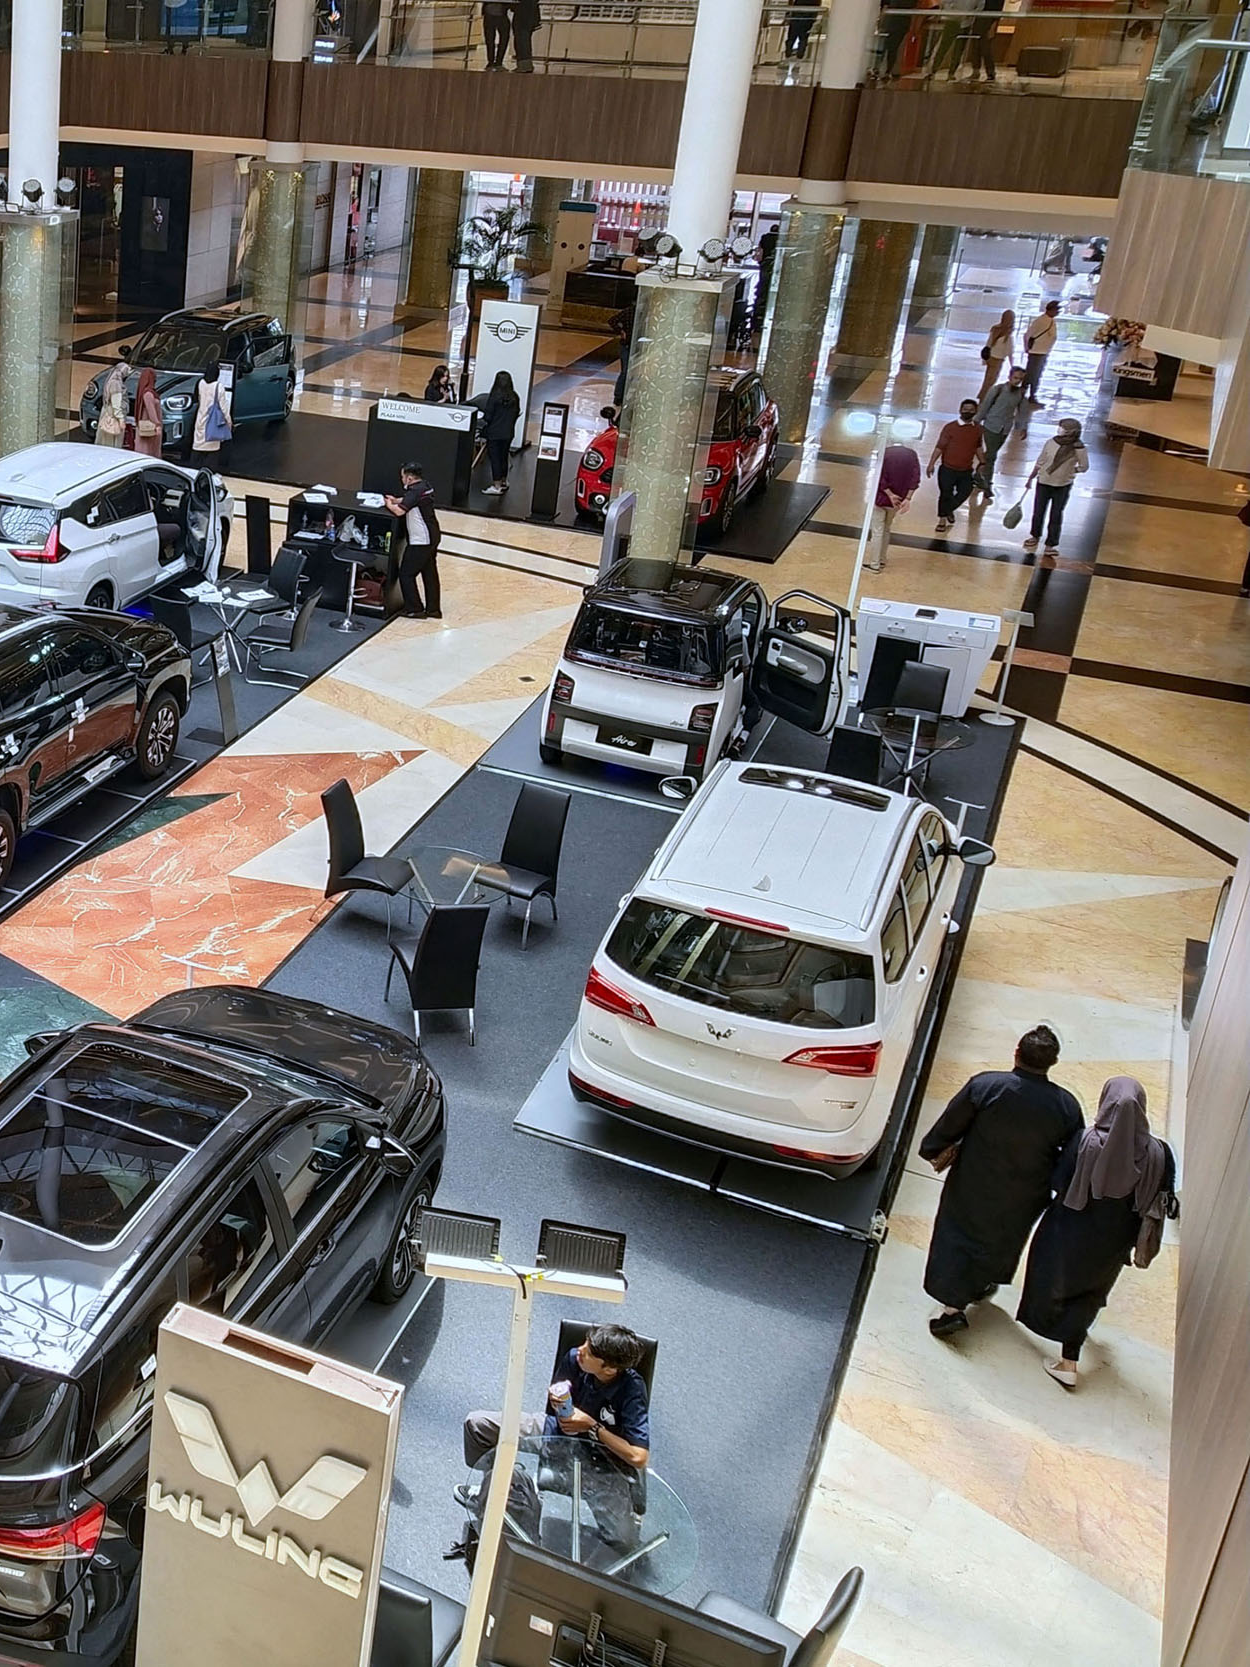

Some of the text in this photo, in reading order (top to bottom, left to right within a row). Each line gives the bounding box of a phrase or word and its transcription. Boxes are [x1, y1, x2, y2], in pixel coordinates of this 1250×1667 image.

[499, 327, 516, 335] MINI
[382, 401, 421, 414] WELCOME
[149, 1480, 364, 1600] WULING
